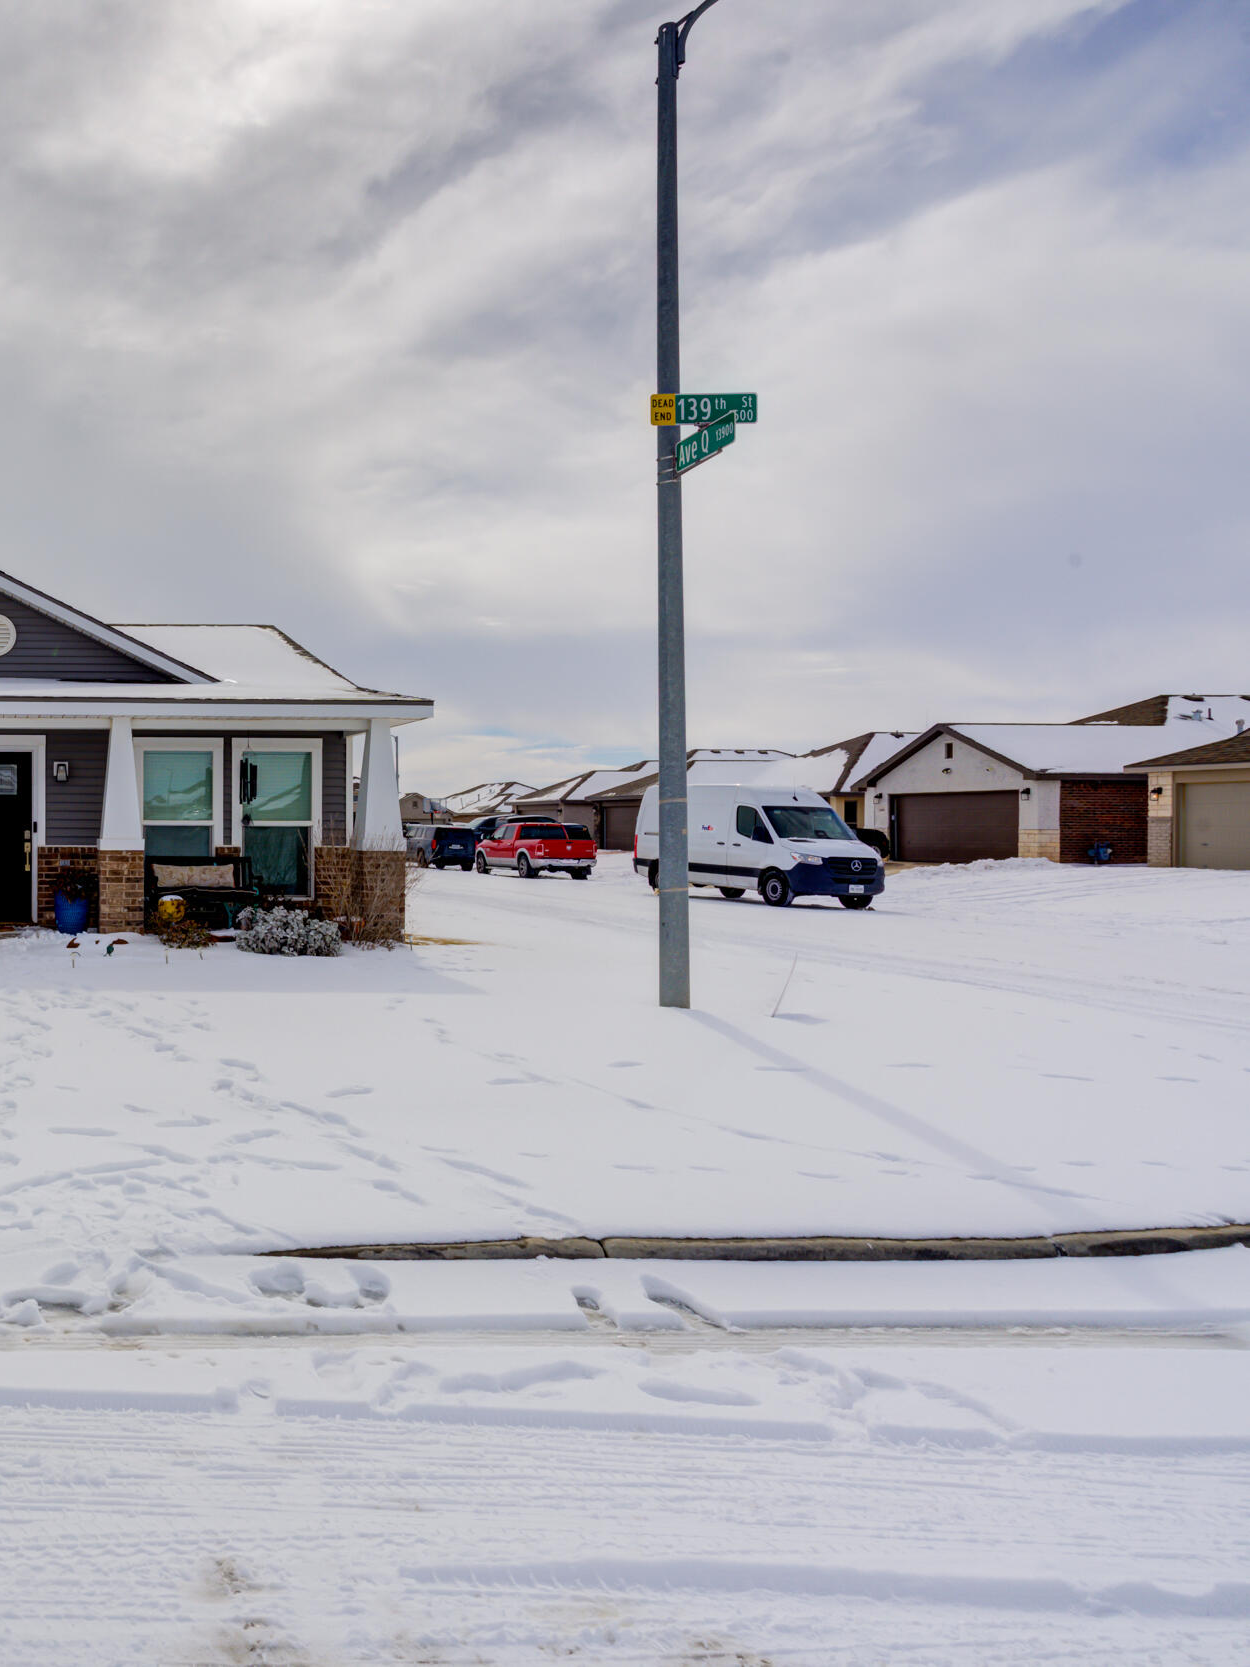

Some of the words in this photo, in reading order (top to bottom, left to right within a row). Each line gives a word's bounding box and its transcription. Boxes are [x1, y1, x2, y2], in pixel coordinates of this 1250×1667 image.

[652, 399, 674, 408] DEAD
[741, 395, 753, 408] St
[654, 412, 672, 421] END
[715, 422, 734, 442] 13900
[678, 441, 698, 467] Ave
[701, 430, 709, 454] Q
